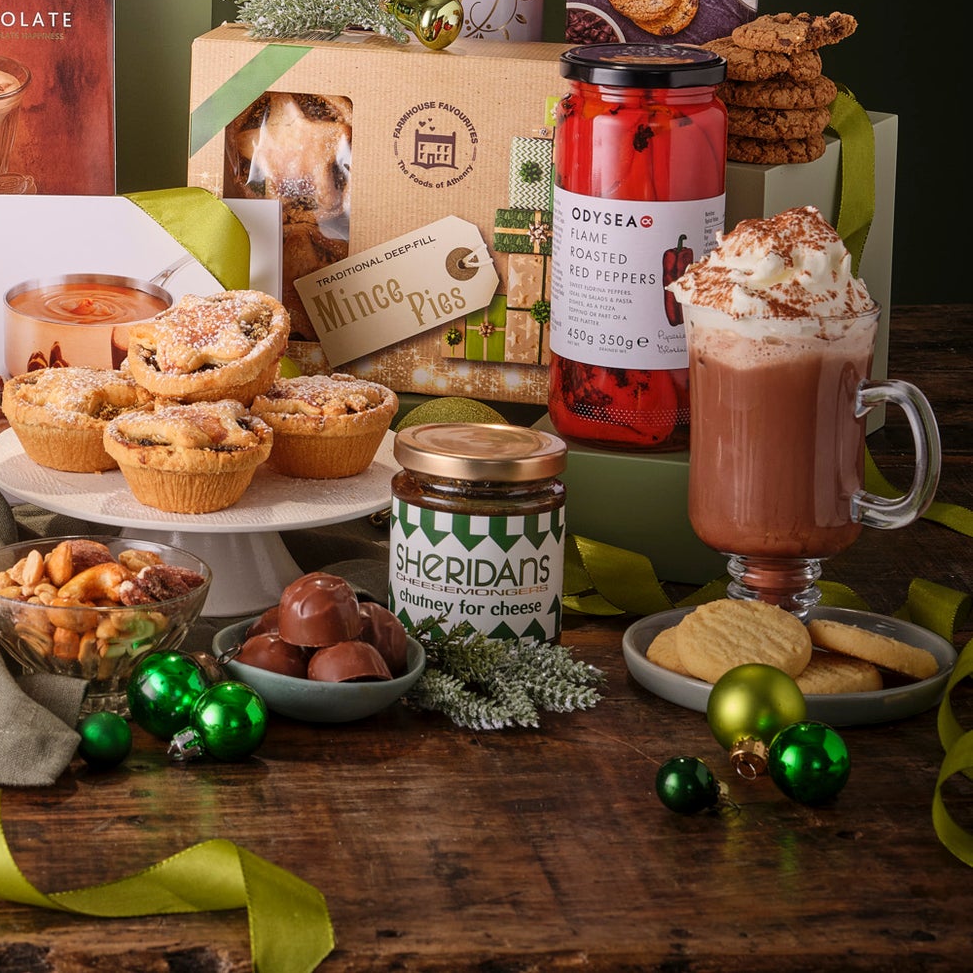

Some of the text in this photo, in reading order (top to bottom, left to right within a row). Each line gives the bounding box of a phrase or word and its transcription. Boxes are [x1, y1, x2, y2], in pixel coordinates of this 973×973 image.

[393, 102, 478, 144] FARMHOUSE FAVOURITES
[398, 160, 408, 174] The
[409, 174, 433, 187] Foods
[447, 165, 473, 187] Athenry
[572, 207, 637, 227] ODYSEA
[571, 228, 607, 244] FLAME
[571, 246, 627, 264] ROASTED
[316, 255, 383, 288] TRADITIONAL
[569, 265, 655, 284] RED PEPPERS
[312, 278, 466, 332] Mince Pies
[568, 328, 633, 349] 450g 350g
[396, 572, 548, 596] CHEESEMONGERS
[400, 588, 541, 615] chutney for cheese
